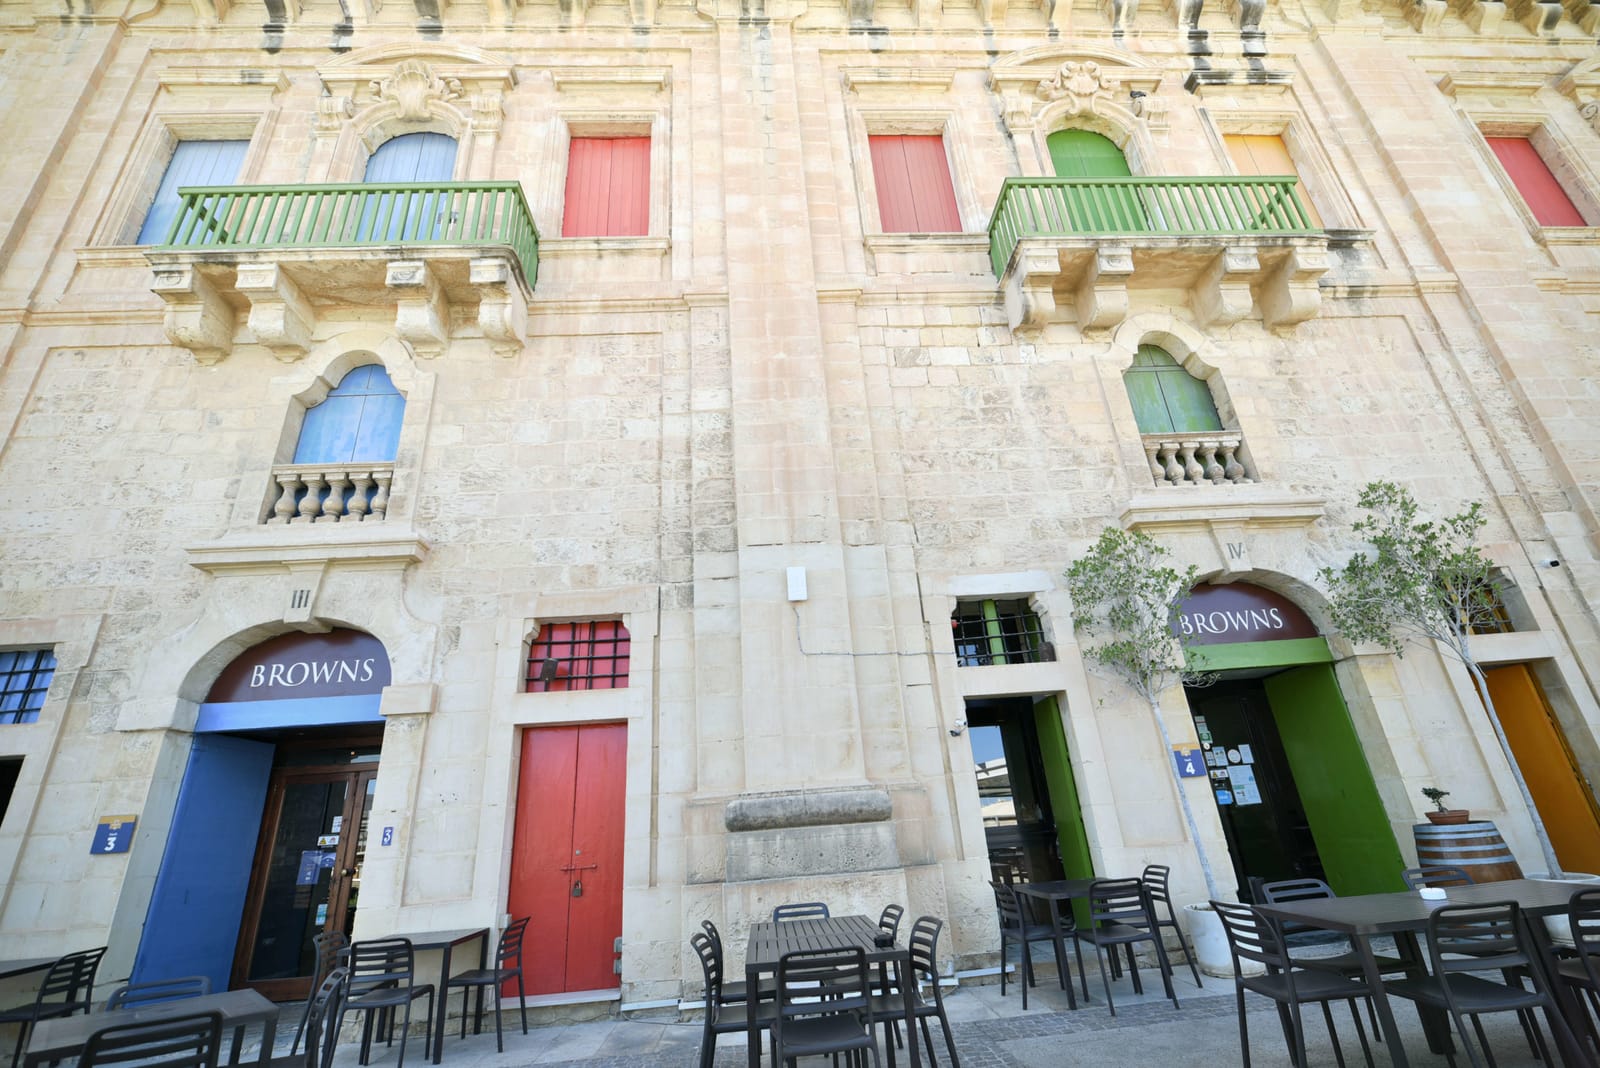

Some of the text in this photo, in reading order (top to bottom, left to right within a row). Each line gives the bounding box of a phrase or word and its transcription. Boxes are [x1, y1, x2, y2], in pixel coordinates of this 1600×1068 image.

[291, 590, 311, 608] III
[1179, 608, 1283, 634] BROWNS
[250, 659, 375, 688] BROWNS
[1185, 762, 1196, 775] 4
[104, 837, 117, 851] 3
